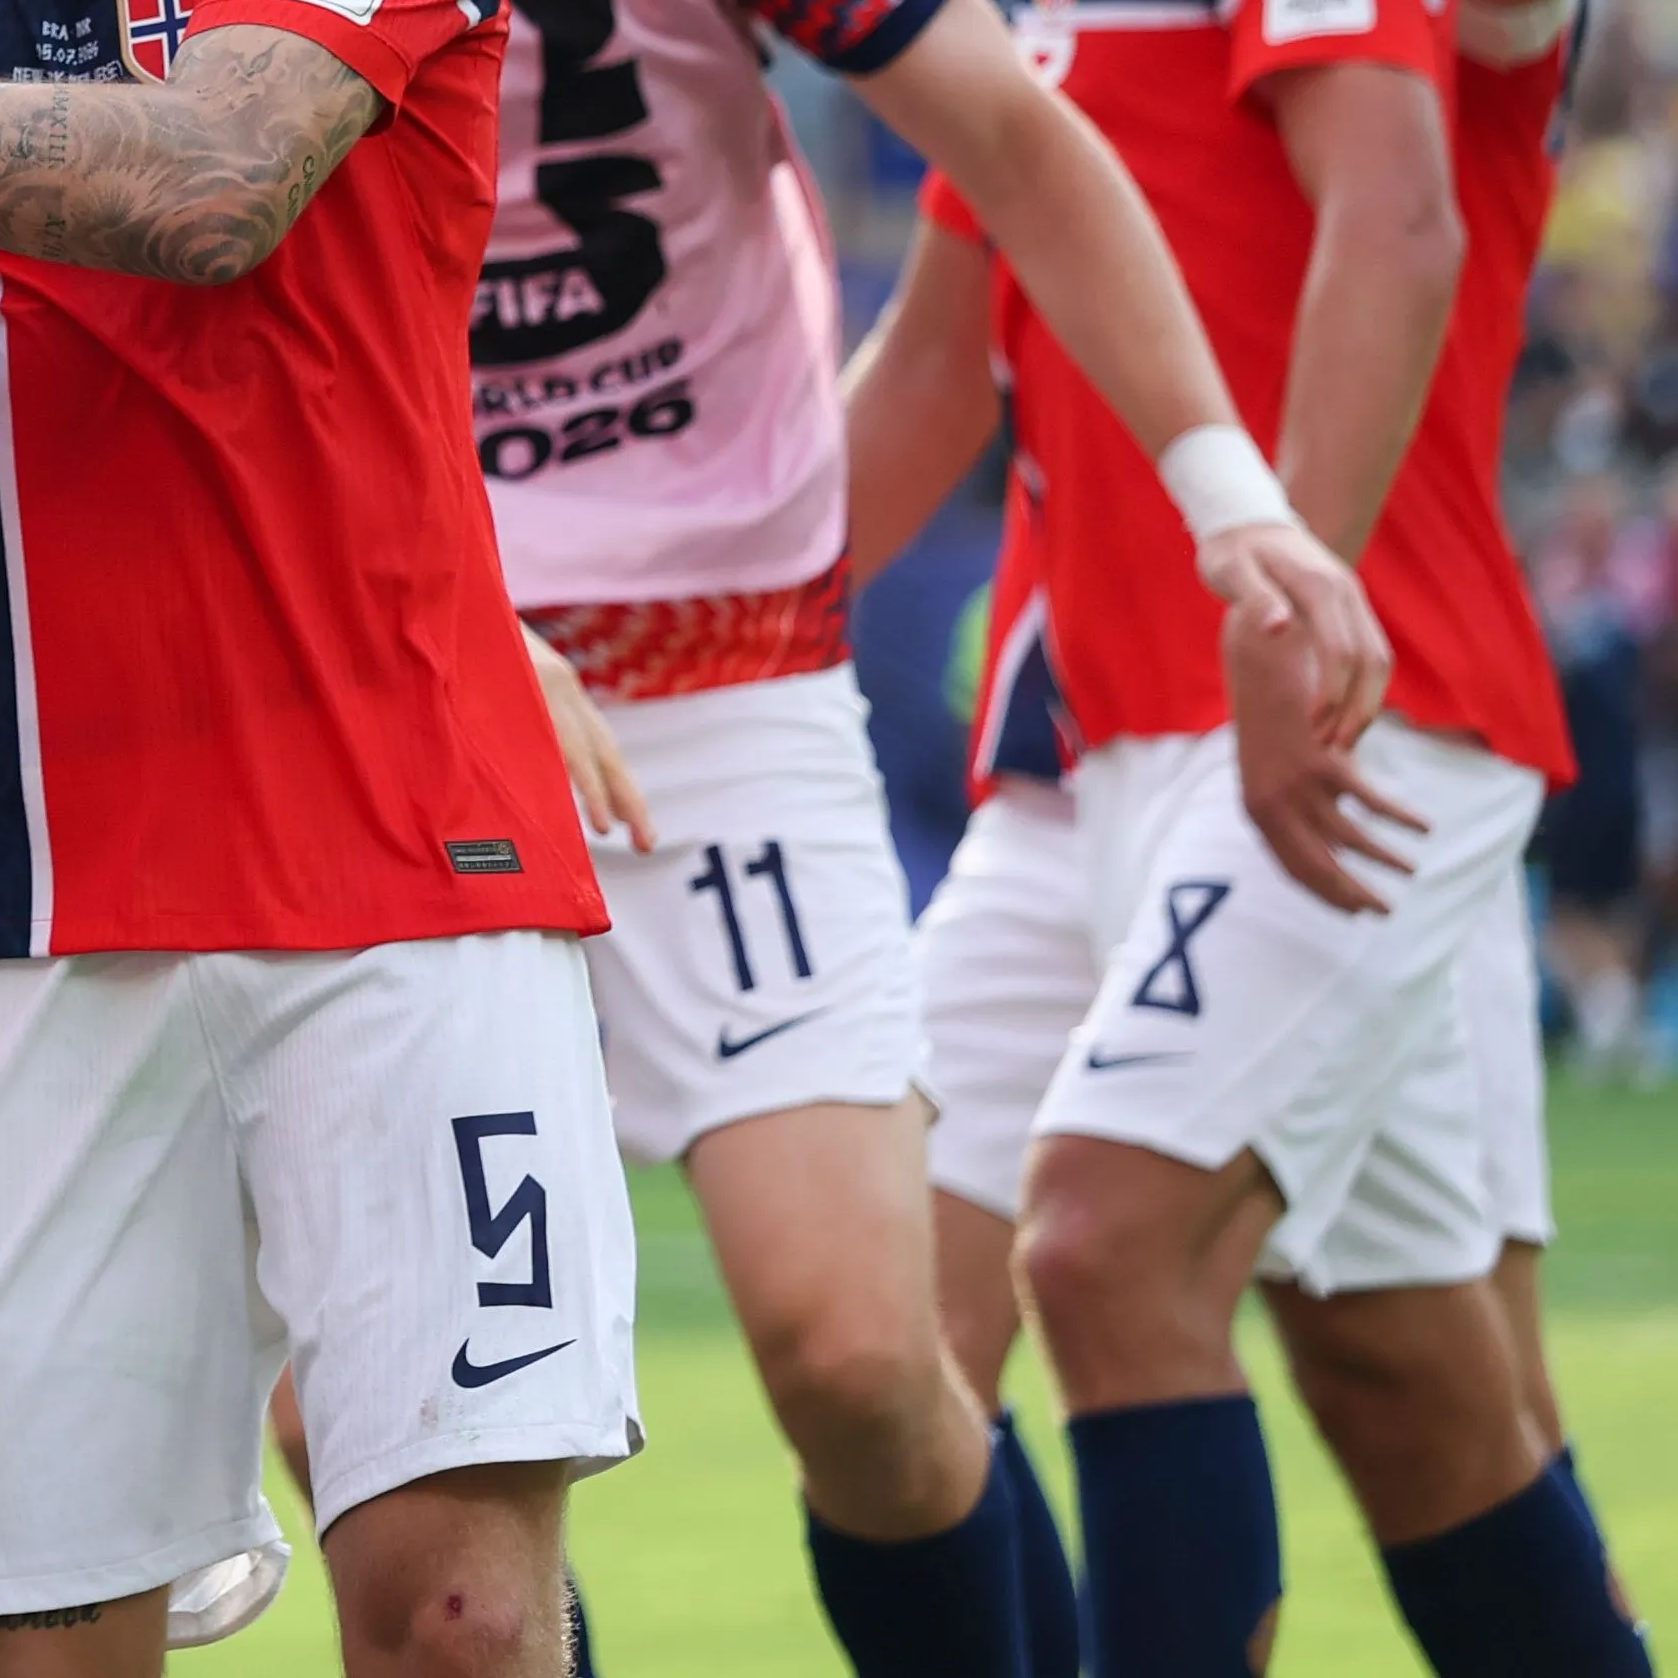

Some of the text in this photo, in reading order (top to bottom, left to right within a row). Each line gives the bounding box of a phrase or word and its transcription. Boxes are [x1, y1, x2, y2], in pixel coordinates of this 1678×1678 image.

[481, 377, 696, 482] 026
[688, 838, 815, 992] 11
[1132, 880, 1235, 1017] 8
[452, 1111, 554, 1310] 5
